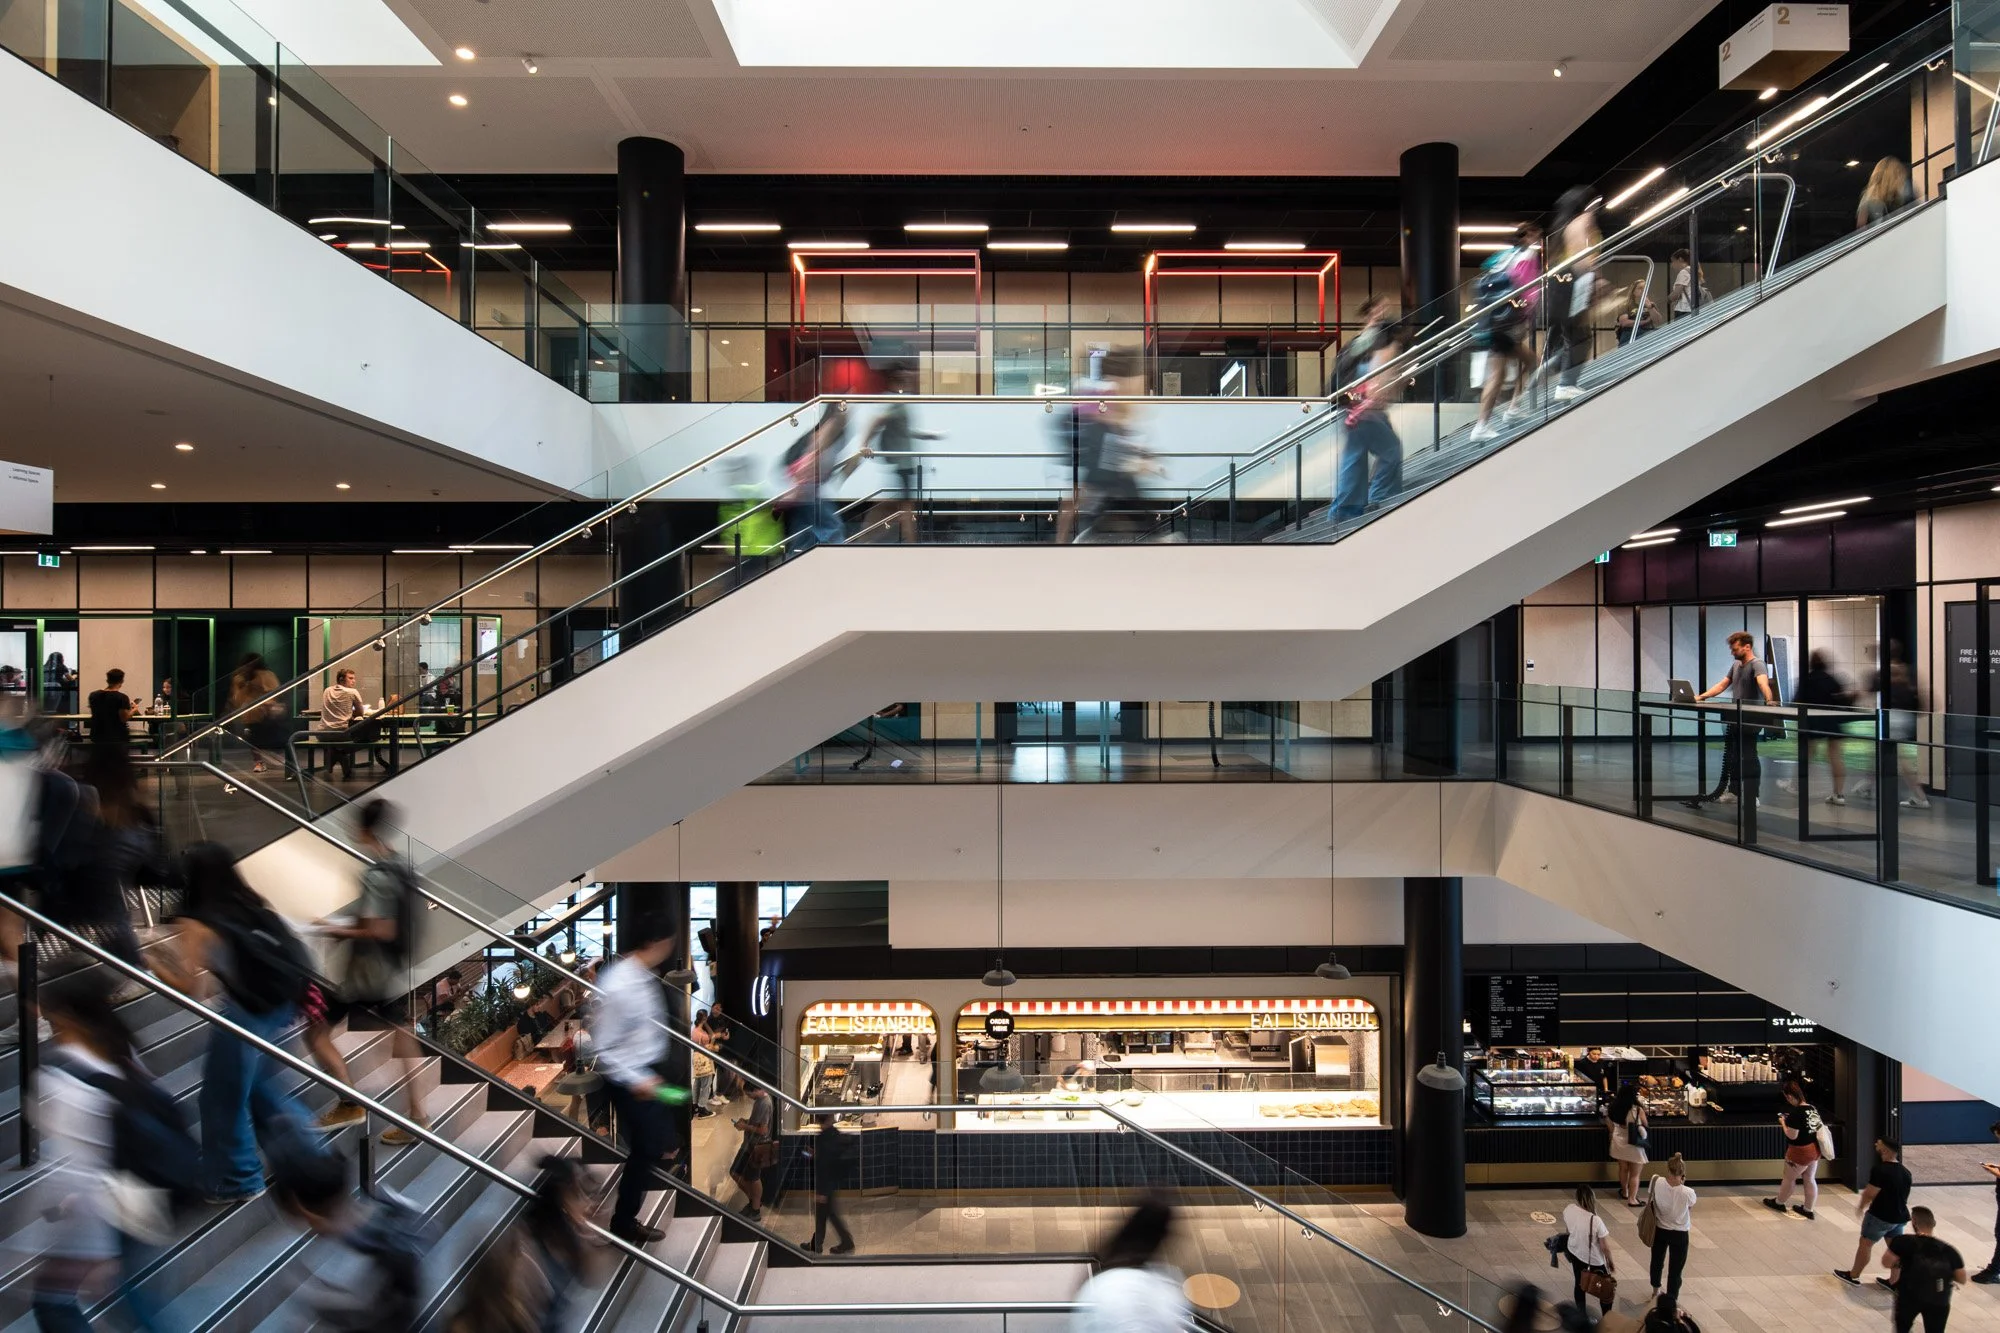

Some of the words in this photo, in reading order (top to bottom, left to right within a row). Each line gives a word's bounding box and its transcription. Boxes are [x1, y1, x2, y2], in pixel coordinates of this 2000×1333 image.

[1777, 6, 1790, 25] 2
[1722, 41, 1731, 62] 2
[807, 1016, 838, 1032] EAT
[849, 1016, 934, 1032] ISTANBUL
[1250, 1013, 1279, 1028] EAT
[1293, 1013, 1376, 1028] ISTANBUL
[1772, 1018, 1785, 1026] ST
